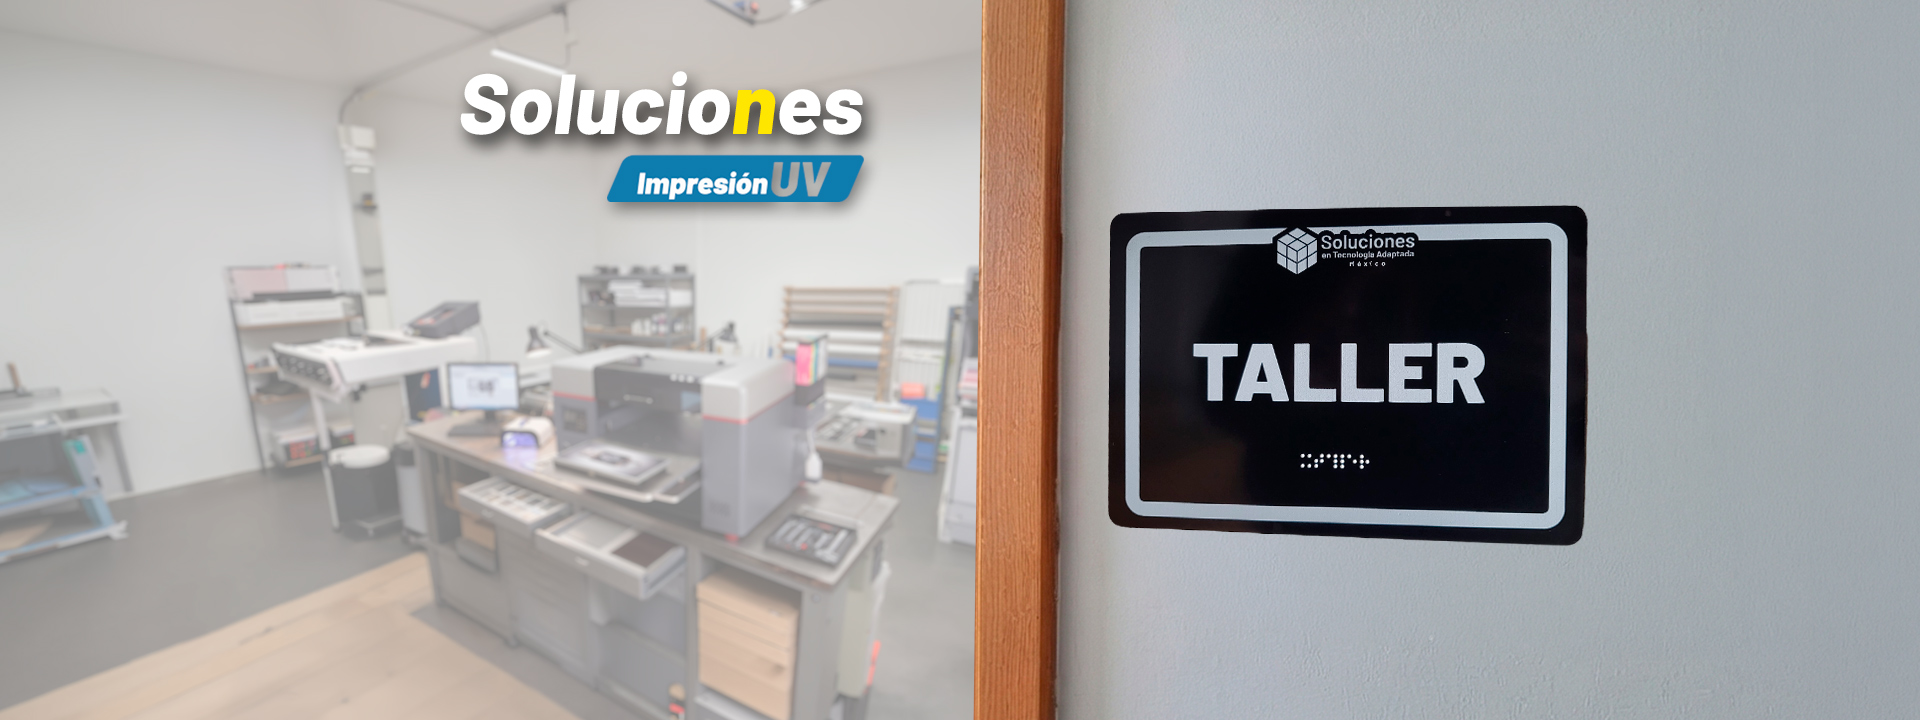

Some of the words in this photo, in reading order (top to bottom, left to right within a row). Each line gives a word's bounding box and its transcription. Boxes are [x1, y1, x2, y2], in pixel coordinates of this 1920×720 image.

[1321, 234, 1415, 250] Soluciones
[1376, 249, 1415, 259] Adaptada
[1193, 343, 1486, 404] TALLER
